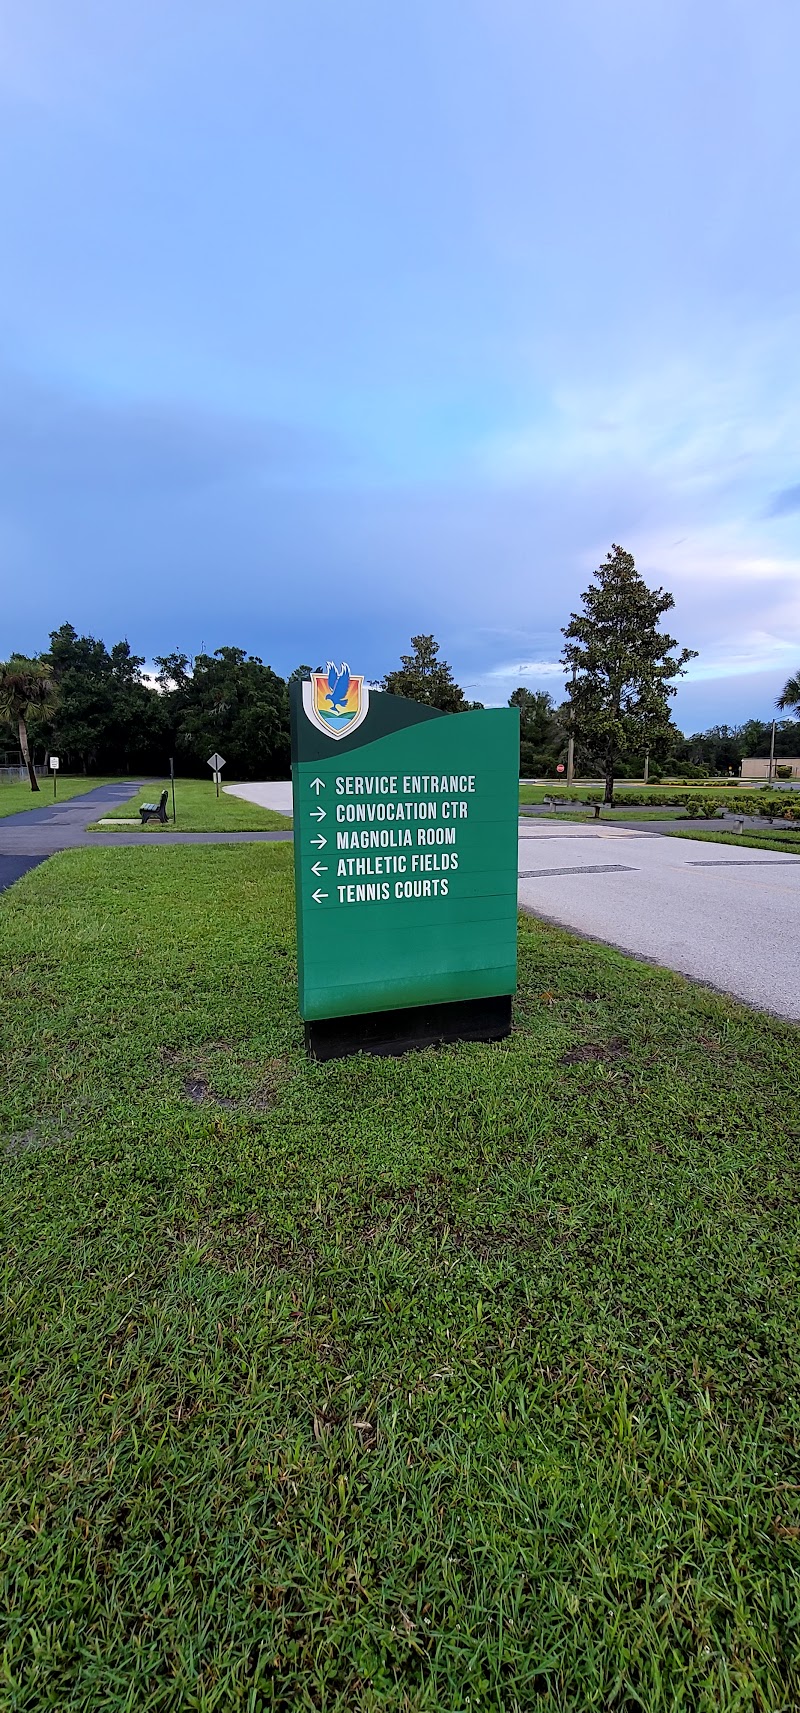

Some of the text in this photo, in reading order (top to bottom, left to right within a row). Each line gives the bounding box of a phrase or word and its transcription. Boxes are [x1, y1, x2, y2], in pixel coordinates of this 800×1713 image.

[335, 775, 476, 795] SERVICE ENTRANCE
[336, 801, 468, 823] CONVOCATION CTR
[336, 827, 456, 850] MAGNOLIA ROOM
[336, 852, 459, 877] ATHLETIC FIELDS
[336, 878, 449, 903] TENNIS COURTS
